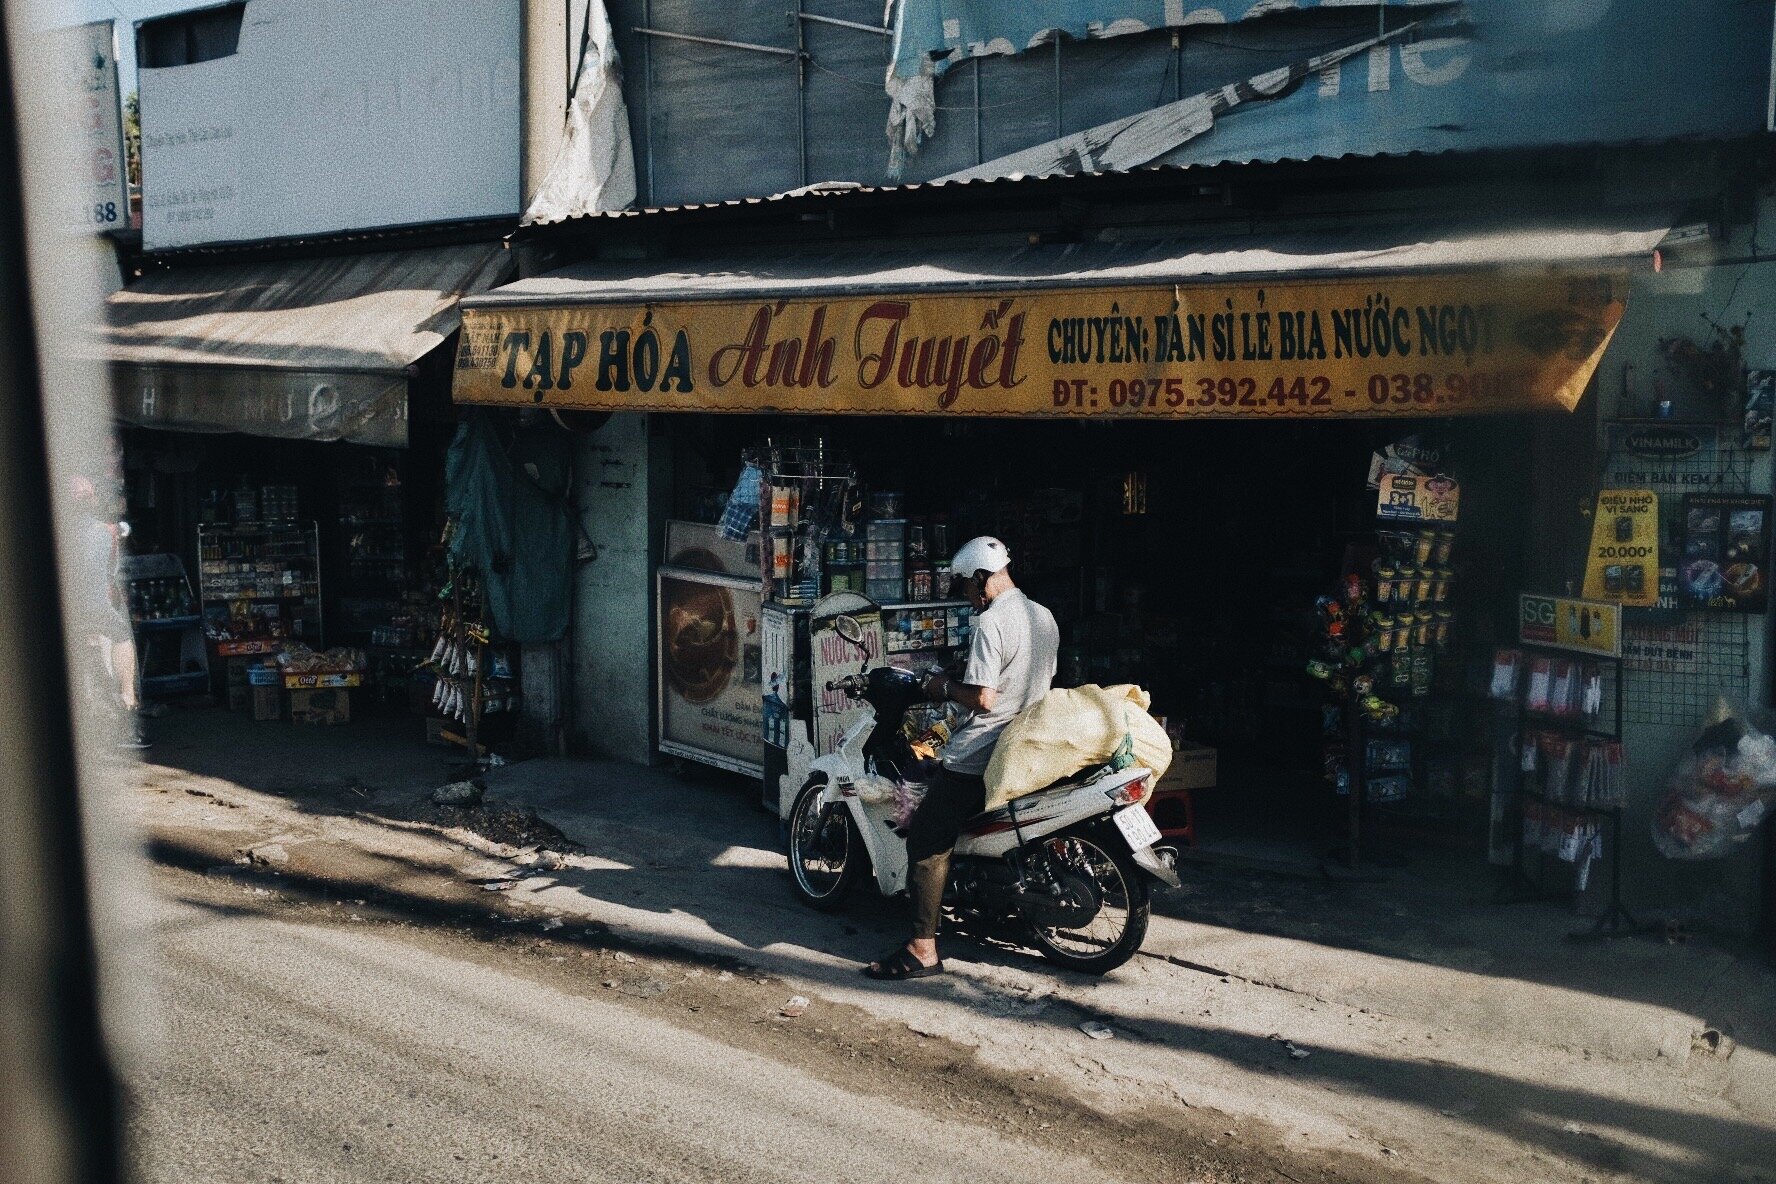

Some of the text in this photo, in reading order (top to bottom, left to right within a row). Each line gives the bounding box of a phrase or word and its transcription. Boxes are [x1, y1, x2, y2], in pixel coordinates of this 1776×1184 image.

[501, 306, 696, 403] TẠP HÓA
[708, 299, 1028, 409] Ánh Tuyết
[1048, 302, 1149, 364] CHUYÊN:
[1154, 299, 1206, 363] BÁN
[1241, 289, 1273, 361] LẺ
[1278, 310, 1327, 360] BIA
[1331, 292, 1411, 359] NƯỚC
[1053, 379, 1098, 408] ĐT:
[1108, 376, 1332, 407] 0975.392.442
[1630, 437, 1696, 450] VINAMILK
